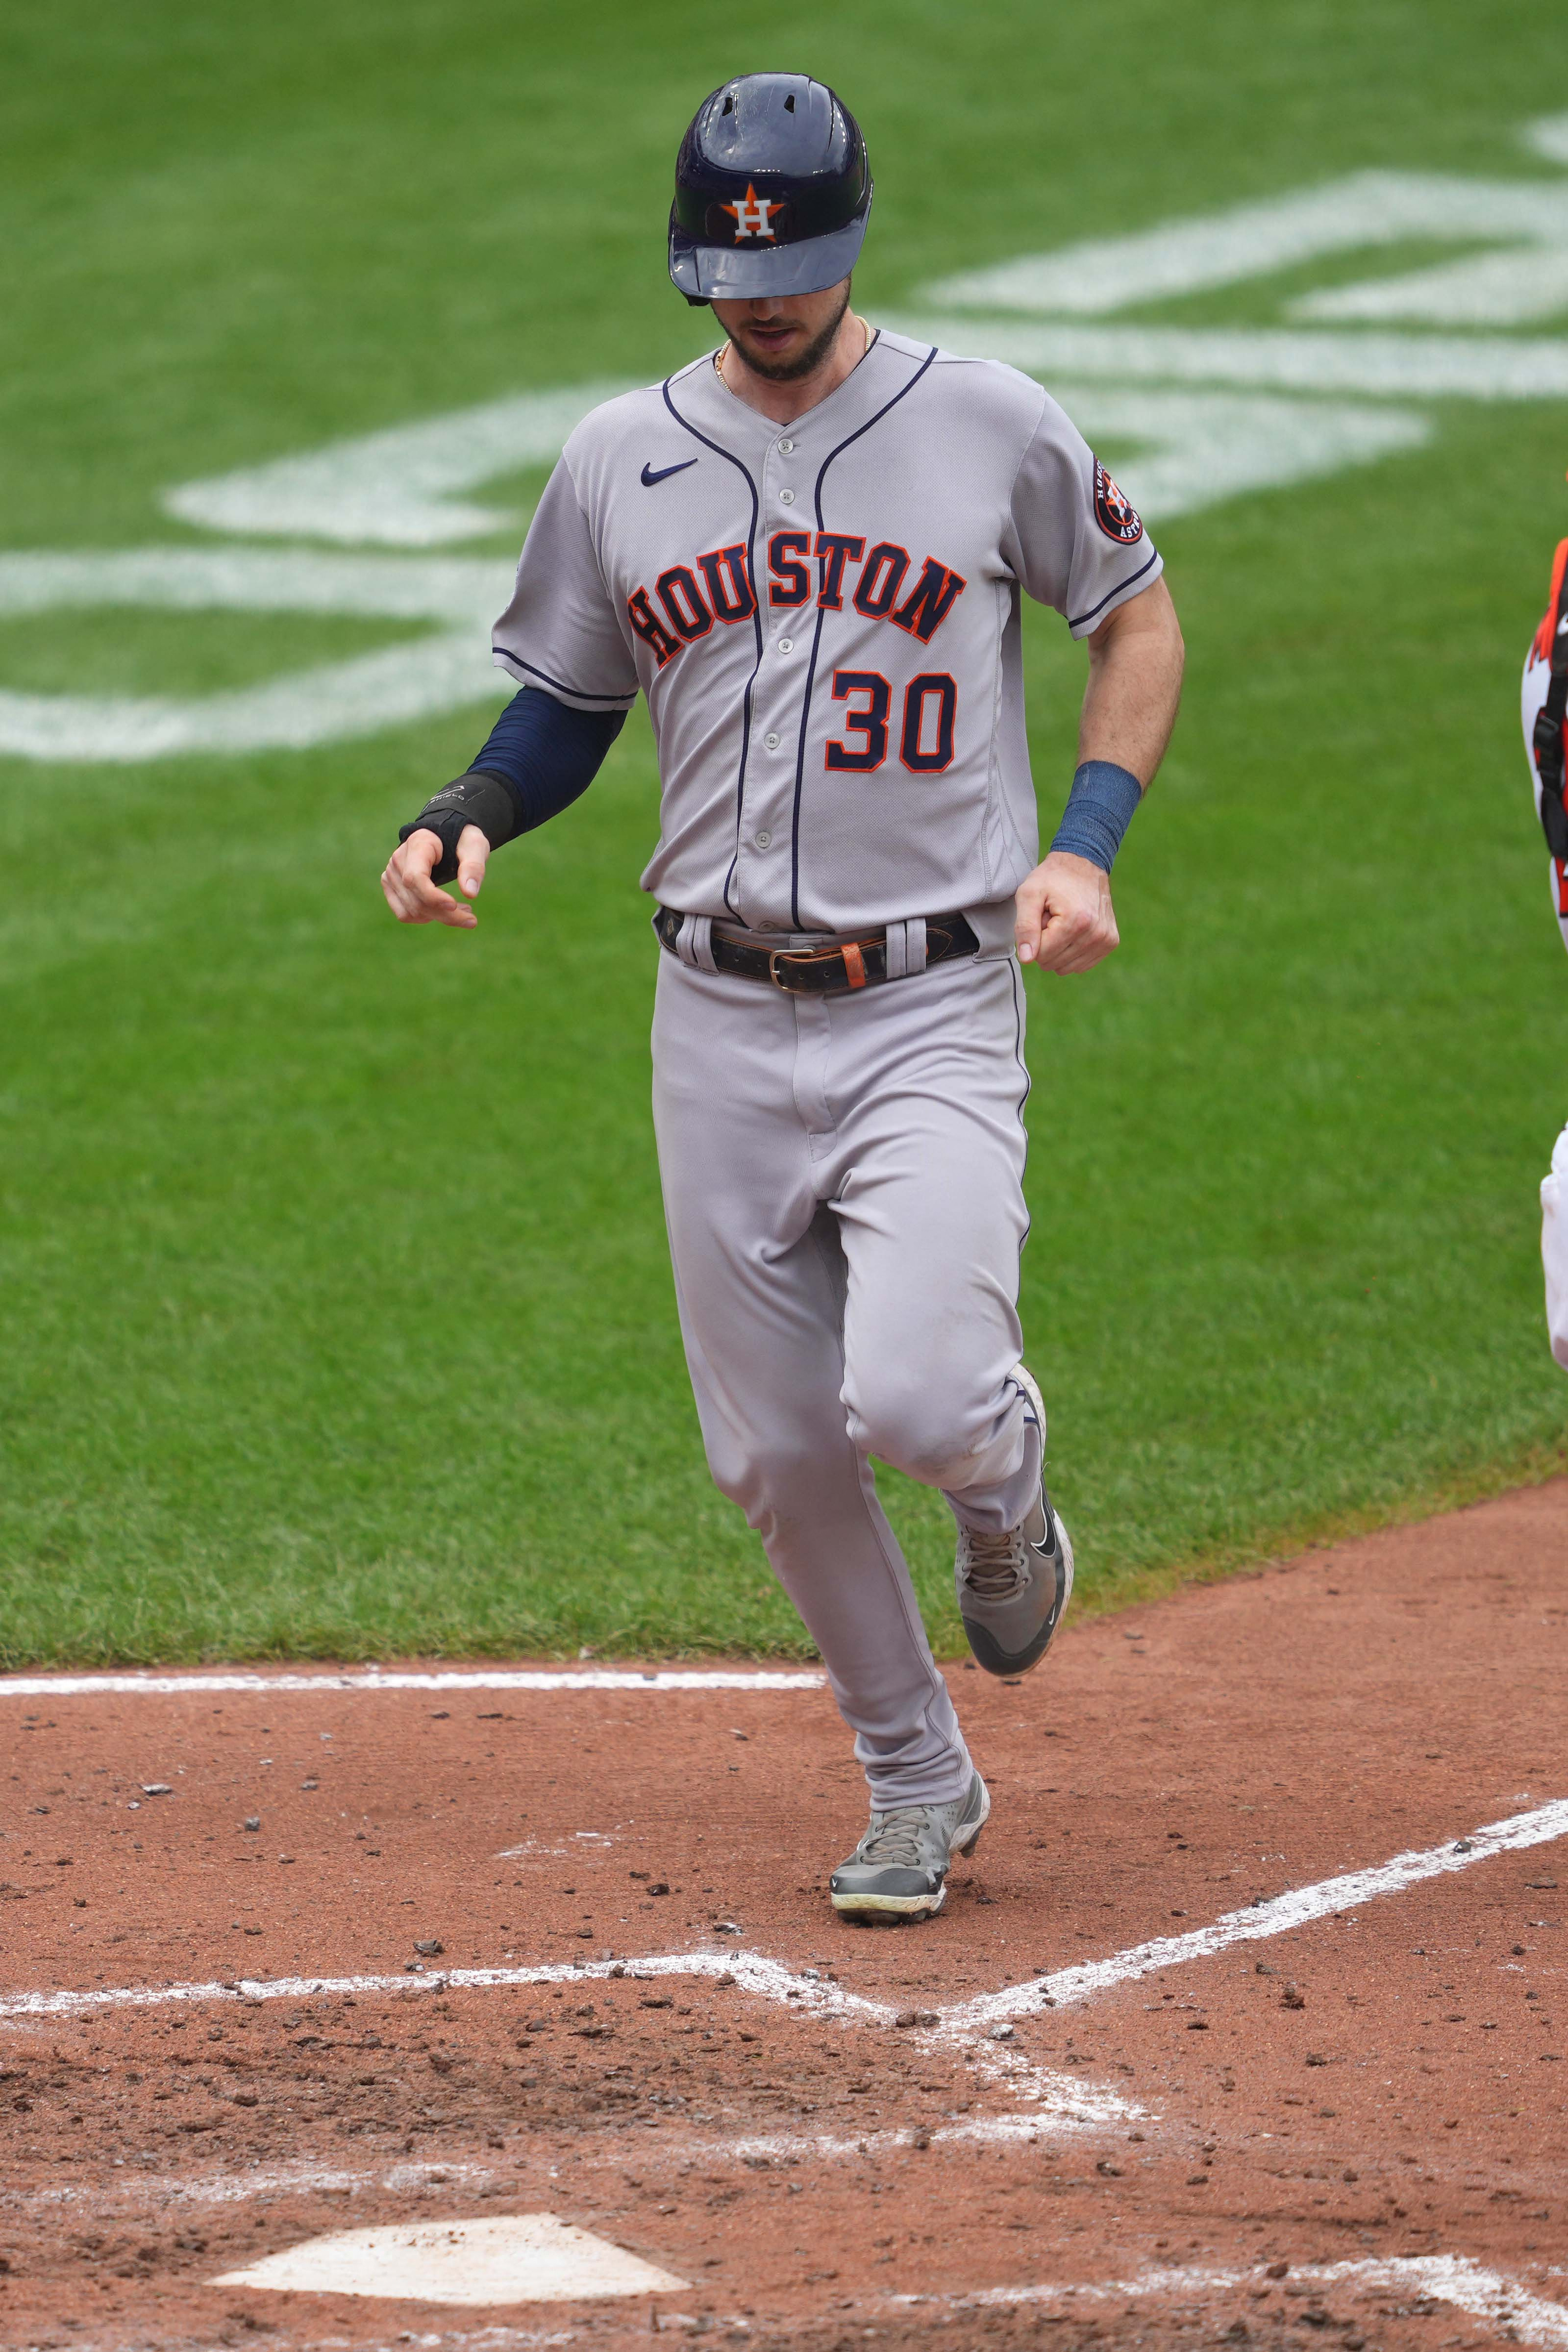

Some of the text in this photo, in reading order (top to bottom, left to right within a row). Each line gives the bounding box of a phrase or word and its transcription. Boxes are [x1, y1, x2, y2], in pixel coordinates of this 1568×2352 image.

[732, 199, 774, 237] H
[628, 531, 967, 671] HOUSTON
[825, 670, 957, 773] 30
